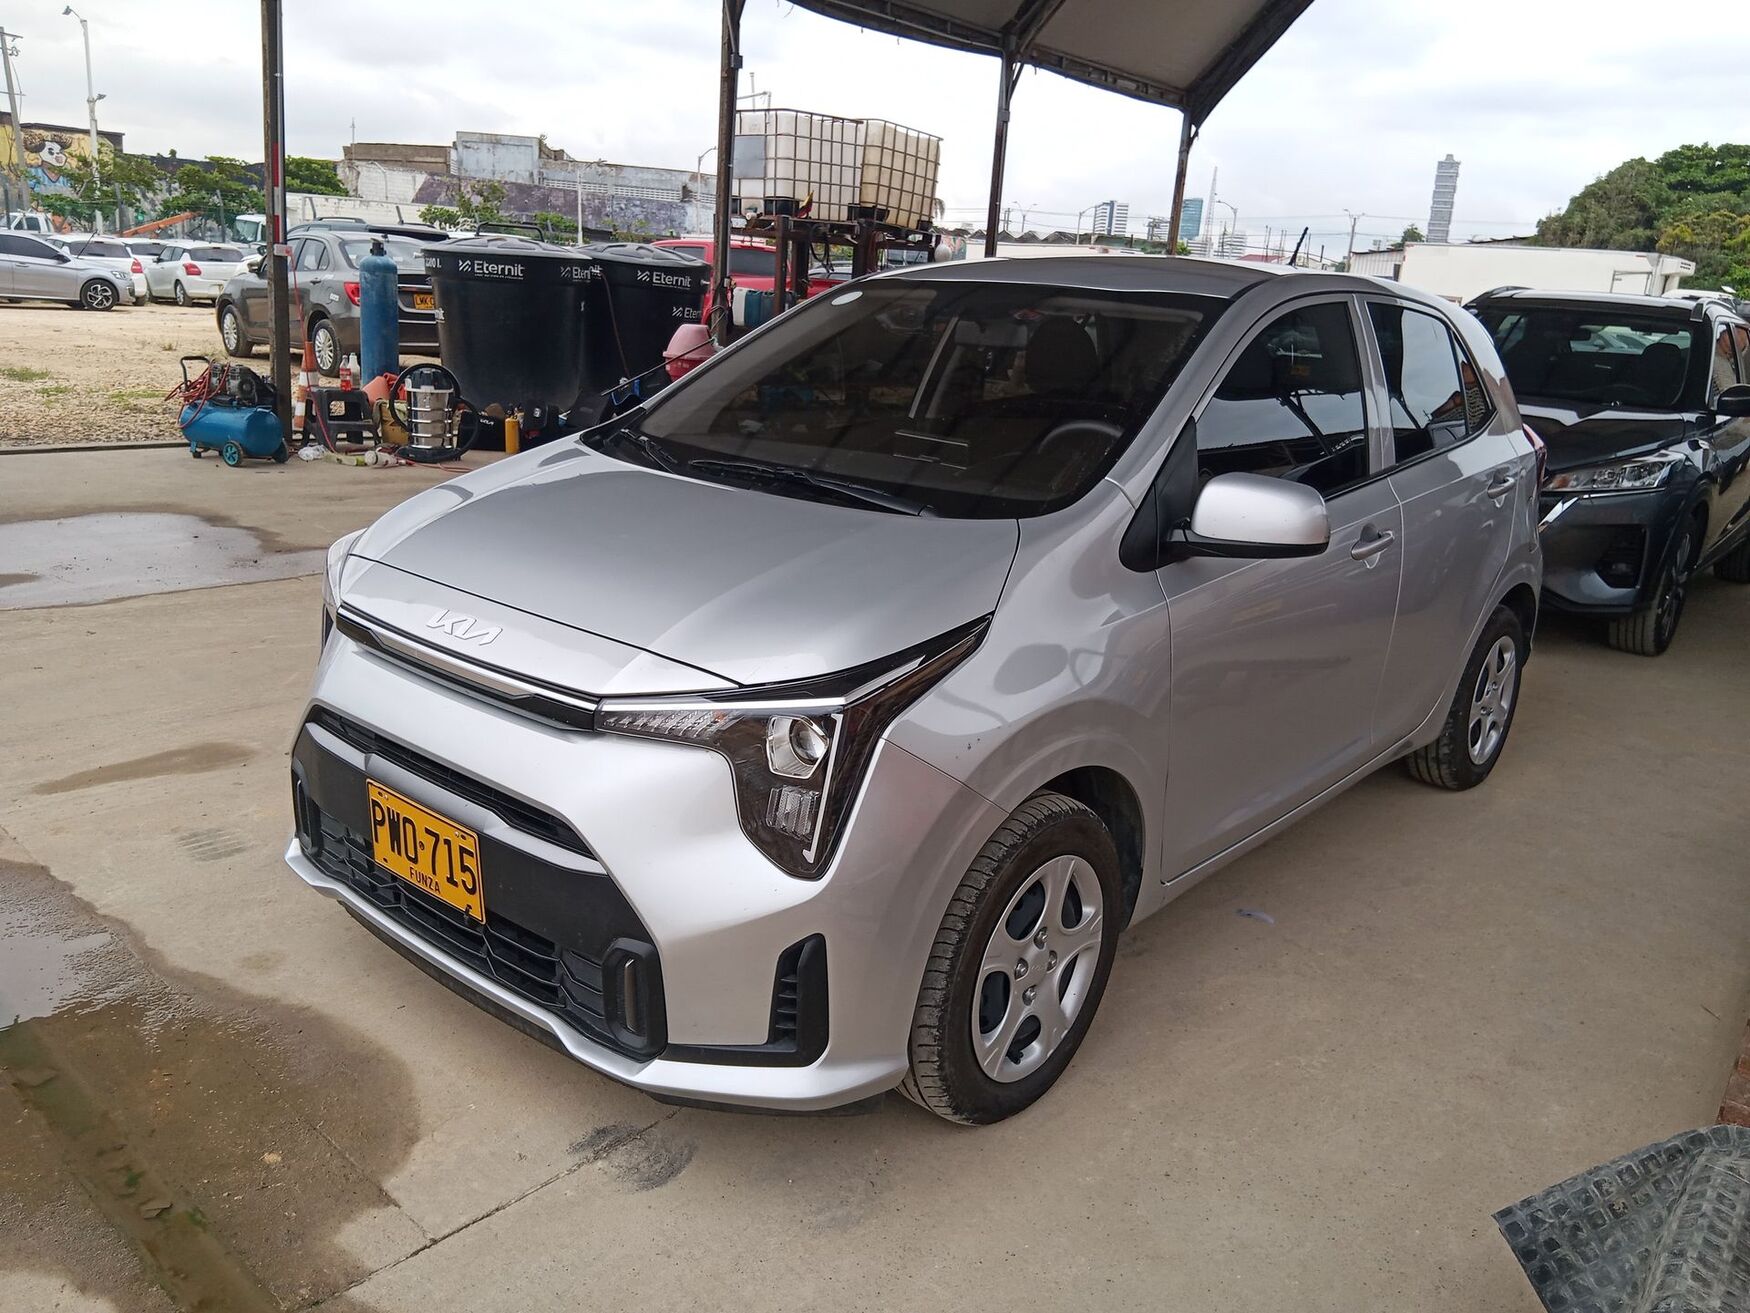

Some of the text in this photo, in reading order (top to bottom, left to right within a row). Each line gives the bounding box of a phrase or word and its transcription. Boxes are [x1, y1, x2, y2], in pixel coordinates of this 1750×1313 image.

[474, 260, 525, 276] Eternit
[652, 271, 691, 287] Eternit
[409, 866, 441, 895] FUNZA
